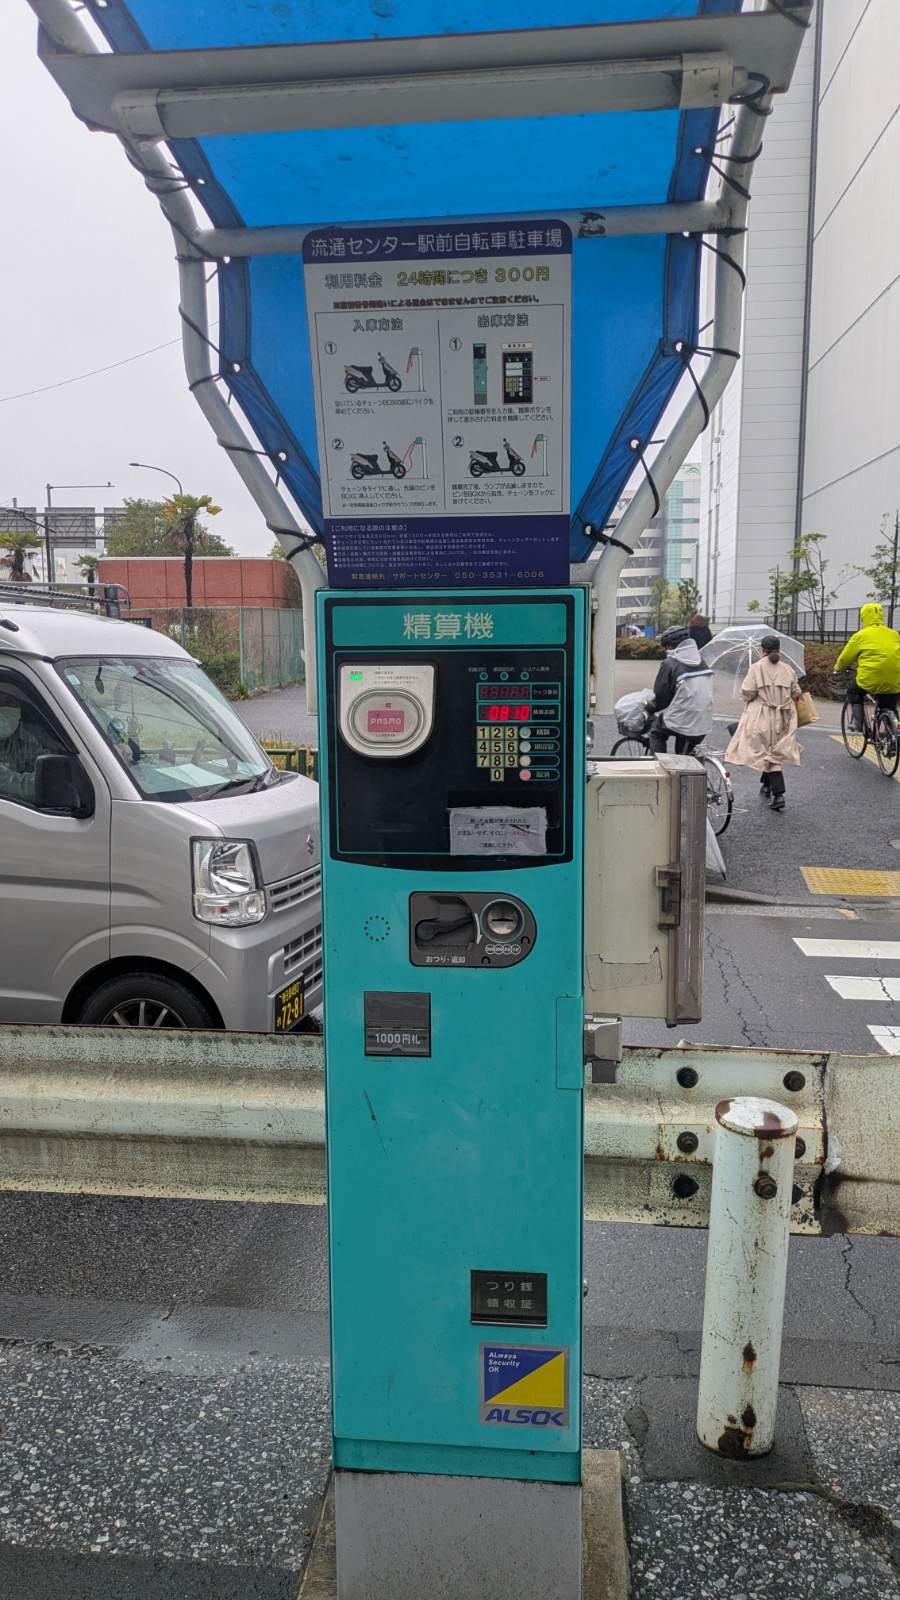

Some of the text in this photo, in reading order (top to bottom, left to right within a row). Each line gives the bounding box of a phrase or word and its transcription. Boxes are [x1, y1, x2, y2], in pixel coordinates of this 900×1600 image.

[311, 228, 563, 257] 流通センター駅前自転車駐車場
[324, 271, 383, 289] 利用料金
[494, 265, 551, 283] 300円
[353, 318, 404, 332] 入庫方法
[477, 313, 529, 328] 出庫方法
[403, 612, 494, 640] 精算機
[488, 704, 531, 720] 0810
[369, 717, 402, 726] PASMO
[480, 728, 515, 738] 1 2 3
[479, 741, 515, 752] 4 5 6
[480, 755, 515, 766] 7 8 9
[494, 769, 501, 779] 0
[425, 955, 466, 964] おつり・返却
[375, 1033, 421, 1044] 1000円札
[486, 1281, 533, 1292] つり銭
[489, 1352, 517, 1360] ALways
[488, 1360, 520, 1368] Security
[485, 1408, 564, 1426] ALSOK
